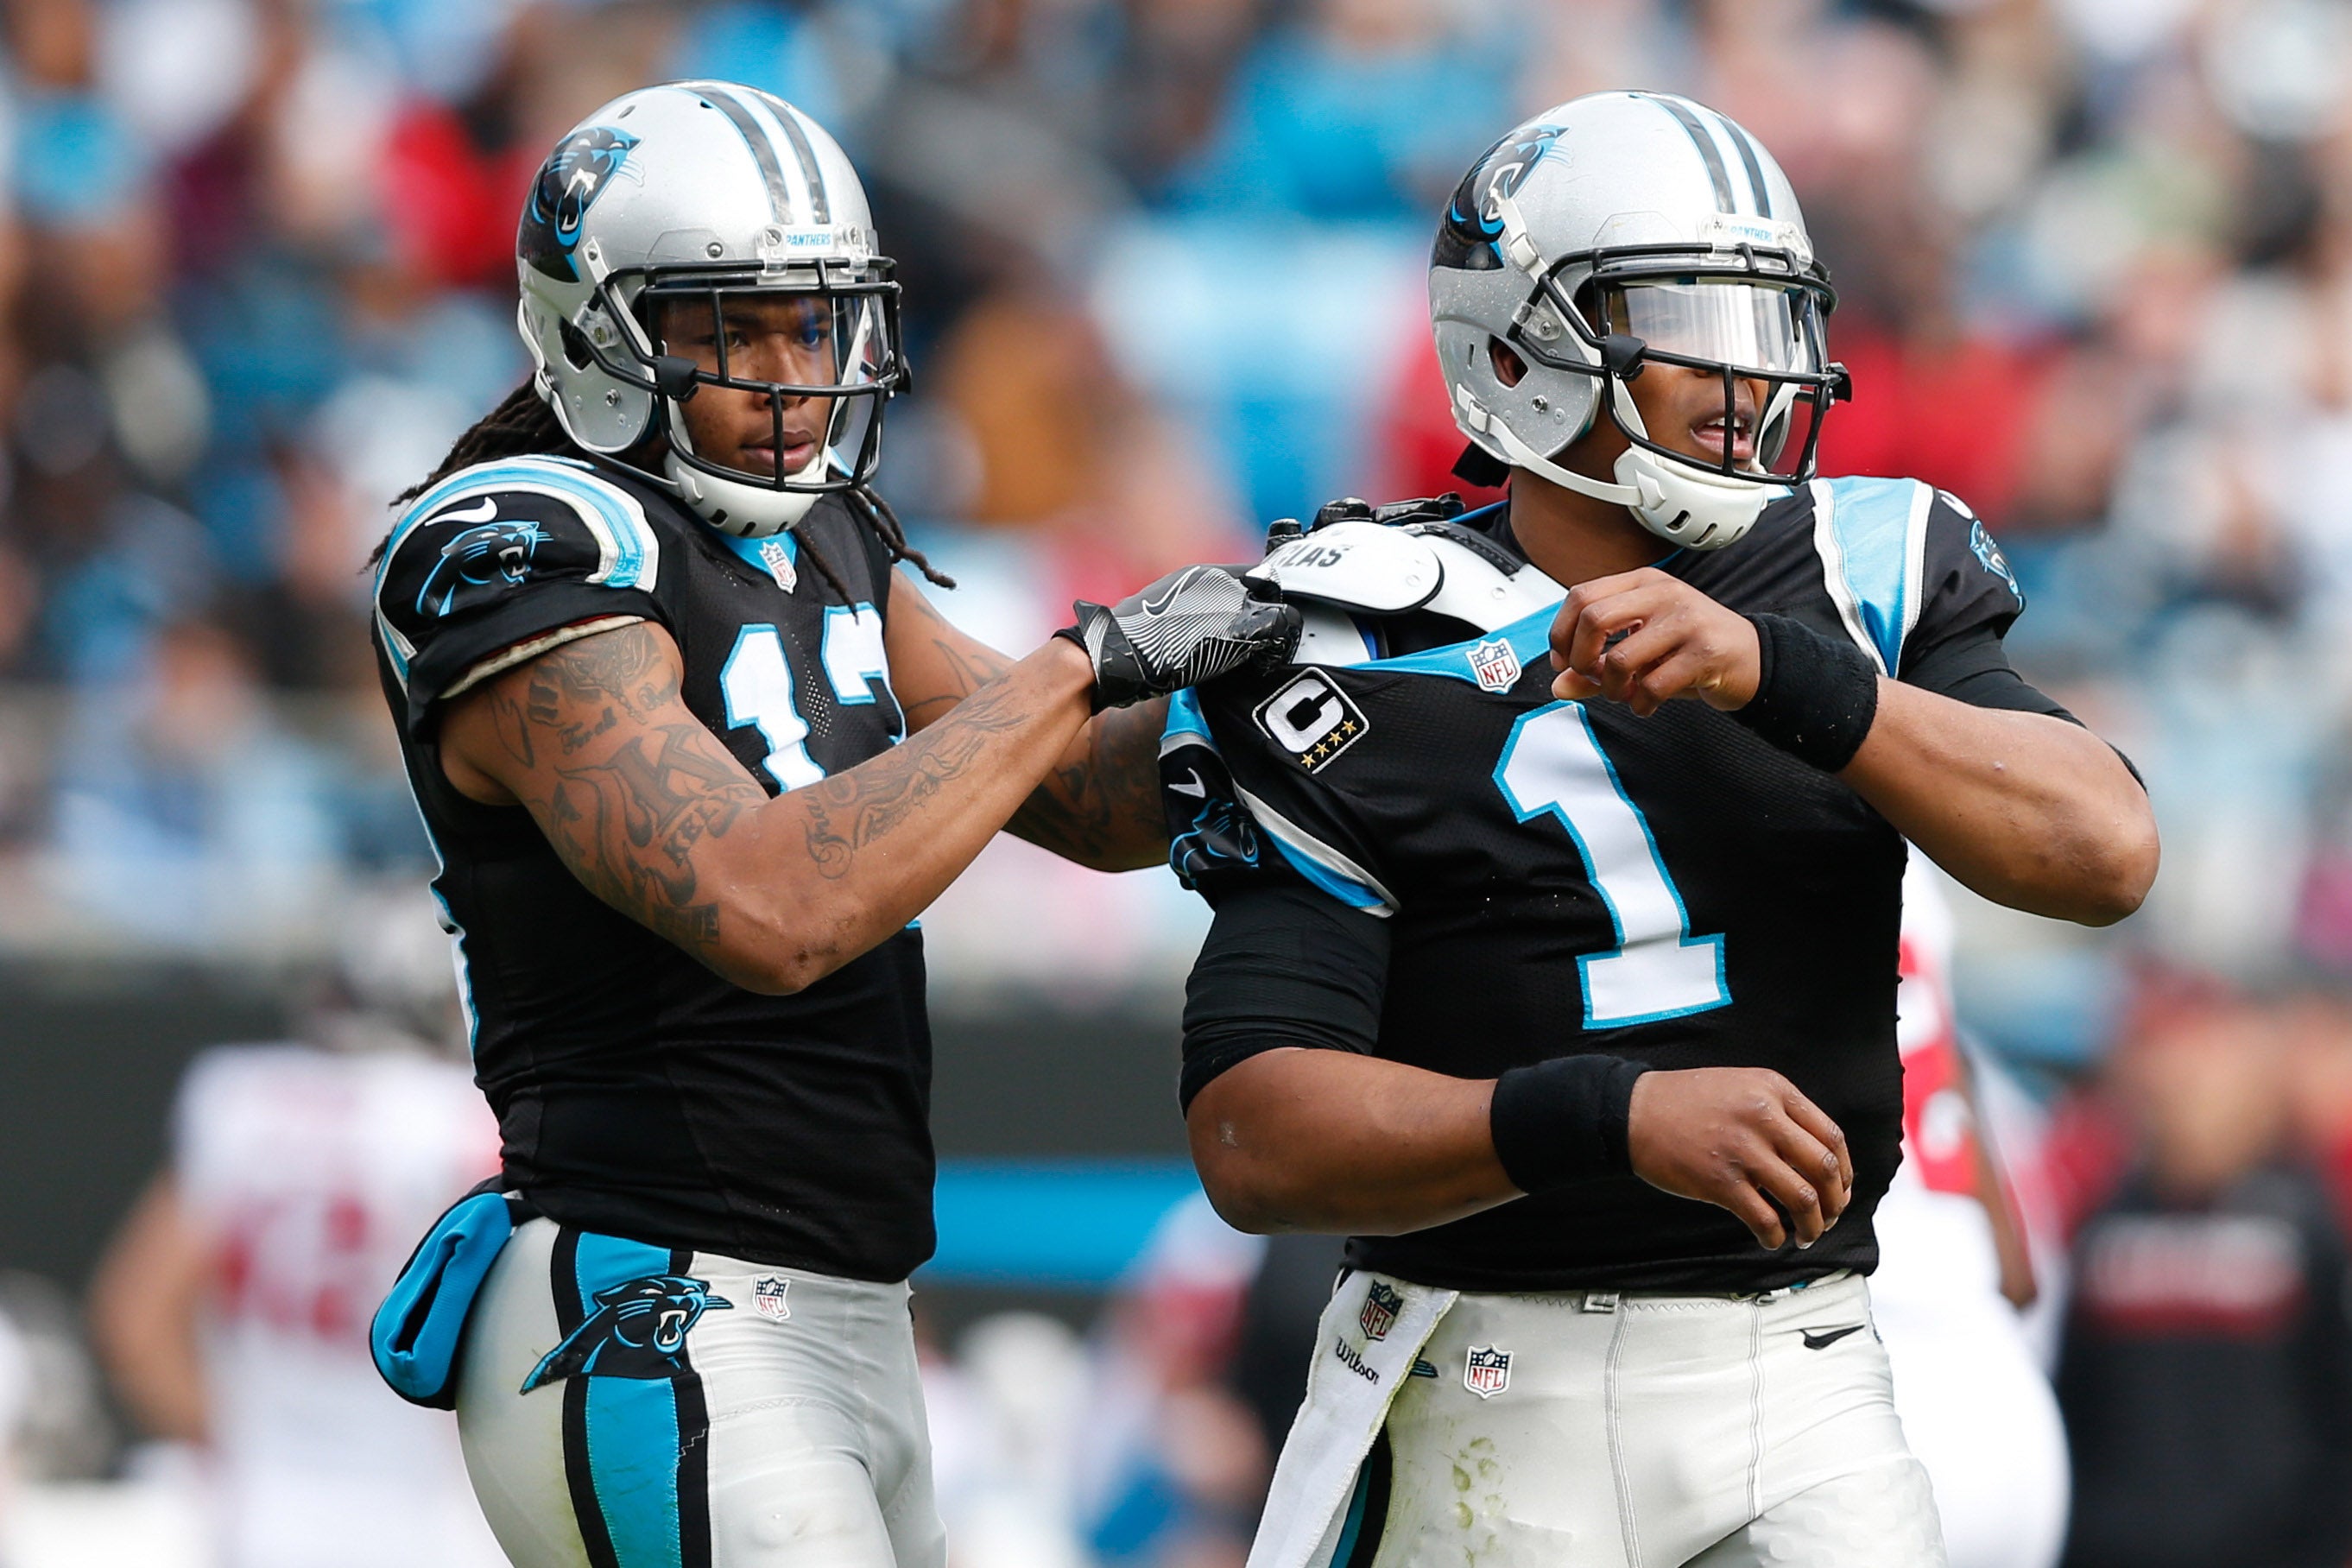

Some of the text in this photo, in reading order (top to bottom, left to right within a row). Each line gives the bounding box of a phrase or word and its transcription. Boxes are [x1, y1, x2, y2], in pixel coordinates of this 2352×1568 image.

[786, 233, 831, 246] PANTHERS
[1482, 660, 1514, 685] NFL
[1265, 678, 1344, 753] C
[1492, 699, 1733, 1030] 1
[757, 1296, 784, 1314] NFL
[1362, 1299, 1390, 1337] NFL
[1470, 1366, 1502, 1389] NFL
